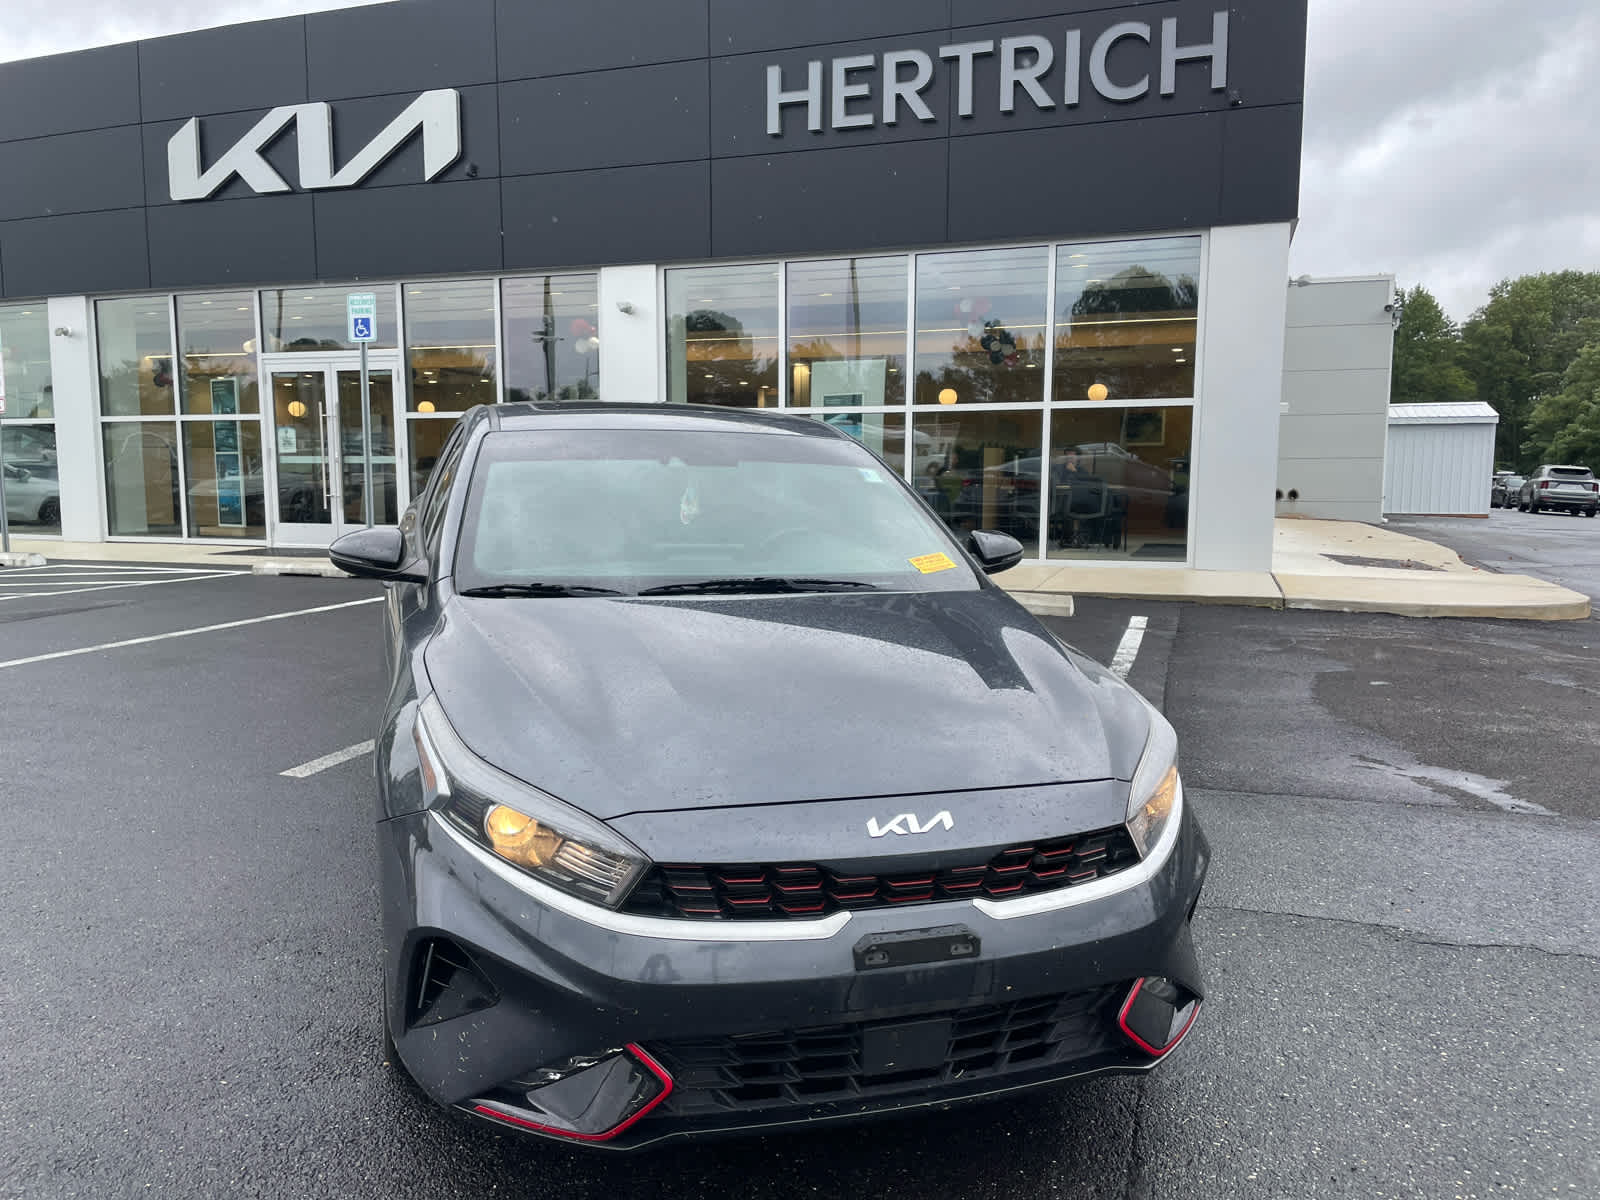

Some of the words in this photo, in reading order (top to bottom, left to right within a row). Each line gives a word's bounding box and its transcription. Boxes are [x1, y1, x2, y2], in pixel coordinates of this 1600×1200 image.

[766, 10, 1229, 135] HERTRICH
[167, 88, 461, 200] KIA
[866, 810, 955, 838] KIA
